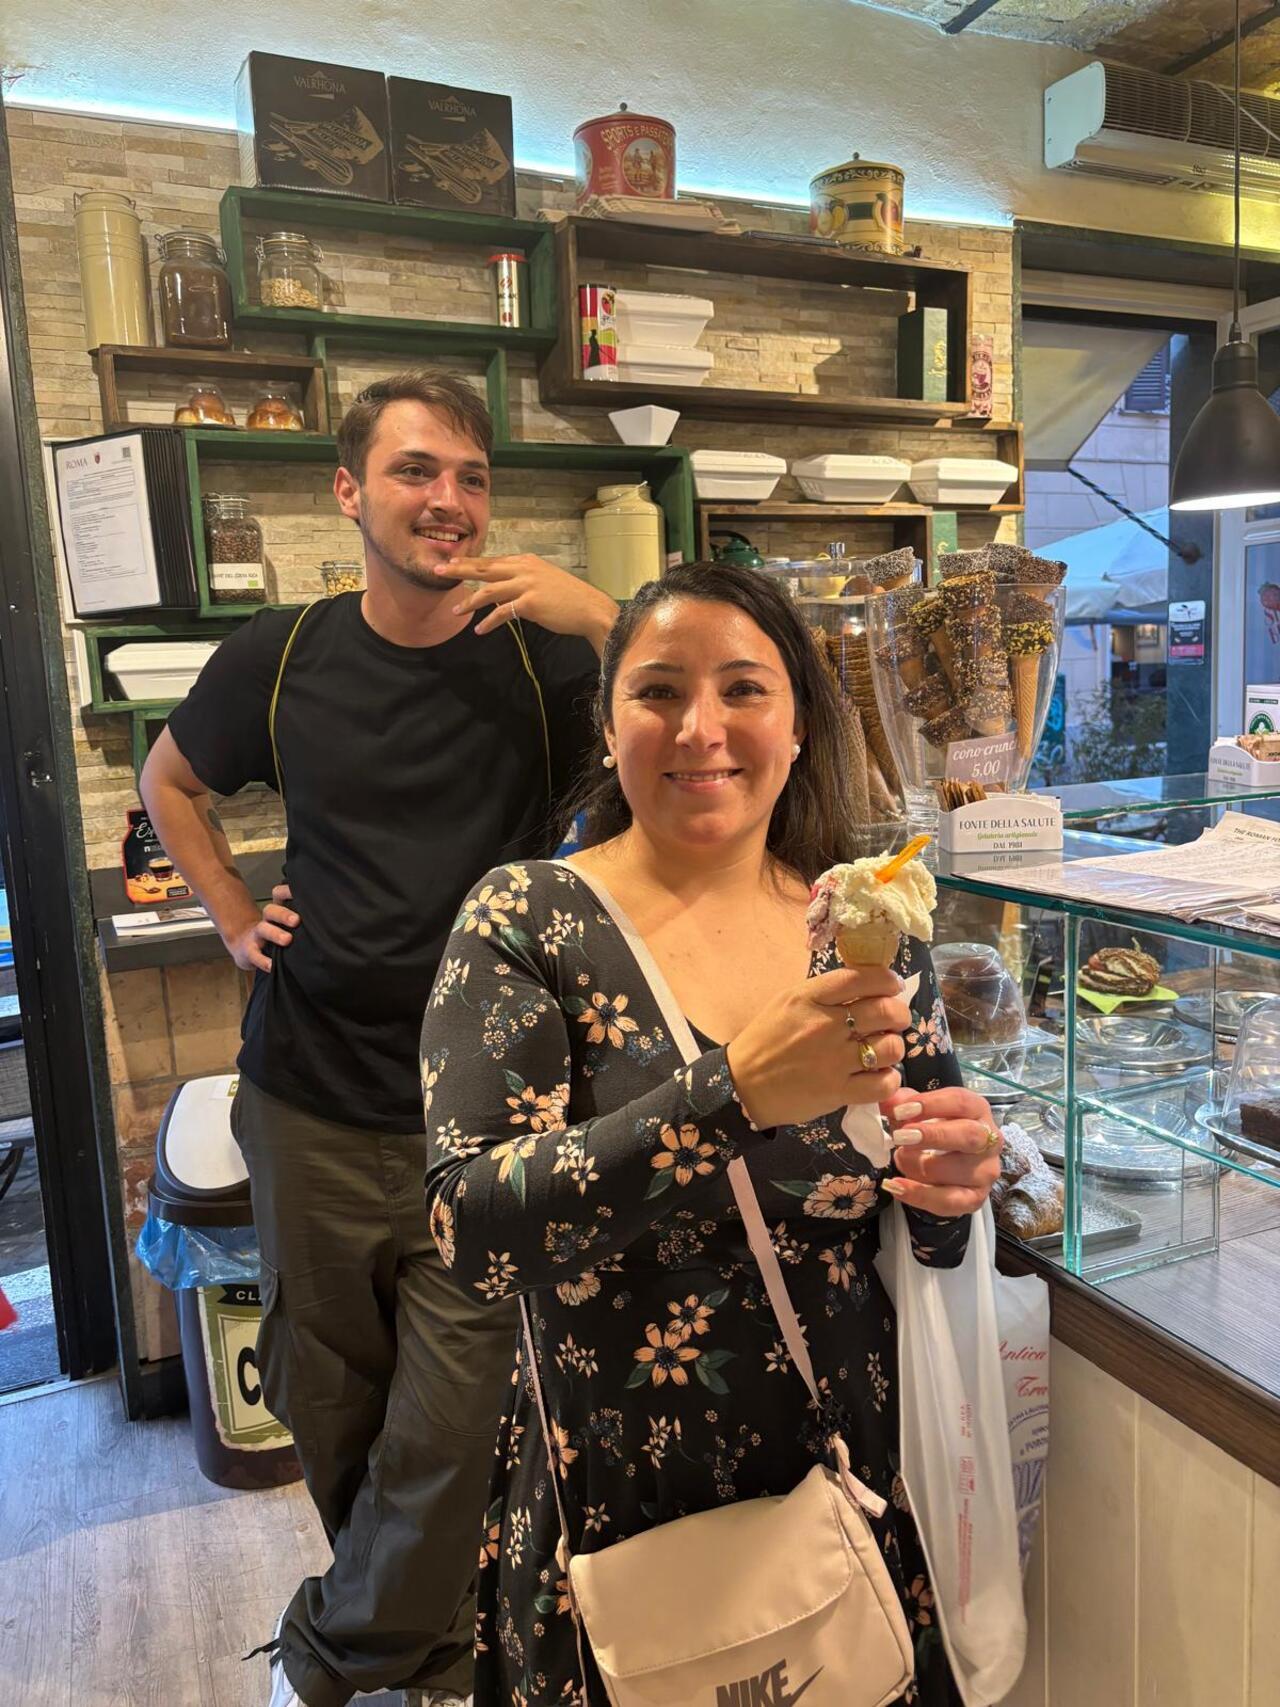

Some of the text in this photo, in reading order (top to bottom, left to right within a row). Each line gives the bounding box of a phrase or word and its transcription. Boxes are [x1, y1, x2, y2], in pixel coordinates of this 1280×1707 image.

[293, 75, 347, 95] VALRHONA
[600, 125, 634, 151] SPORTS
[65, 457, 88, 470] ROMA
[953, 740, 1017, 761] cono crunc
[971, 760, 1001, 778] 5.00
[959, 817, 1057, 830] FONTE DELLA SALUTE
[716, 1658, 789, 1707] NIKE
